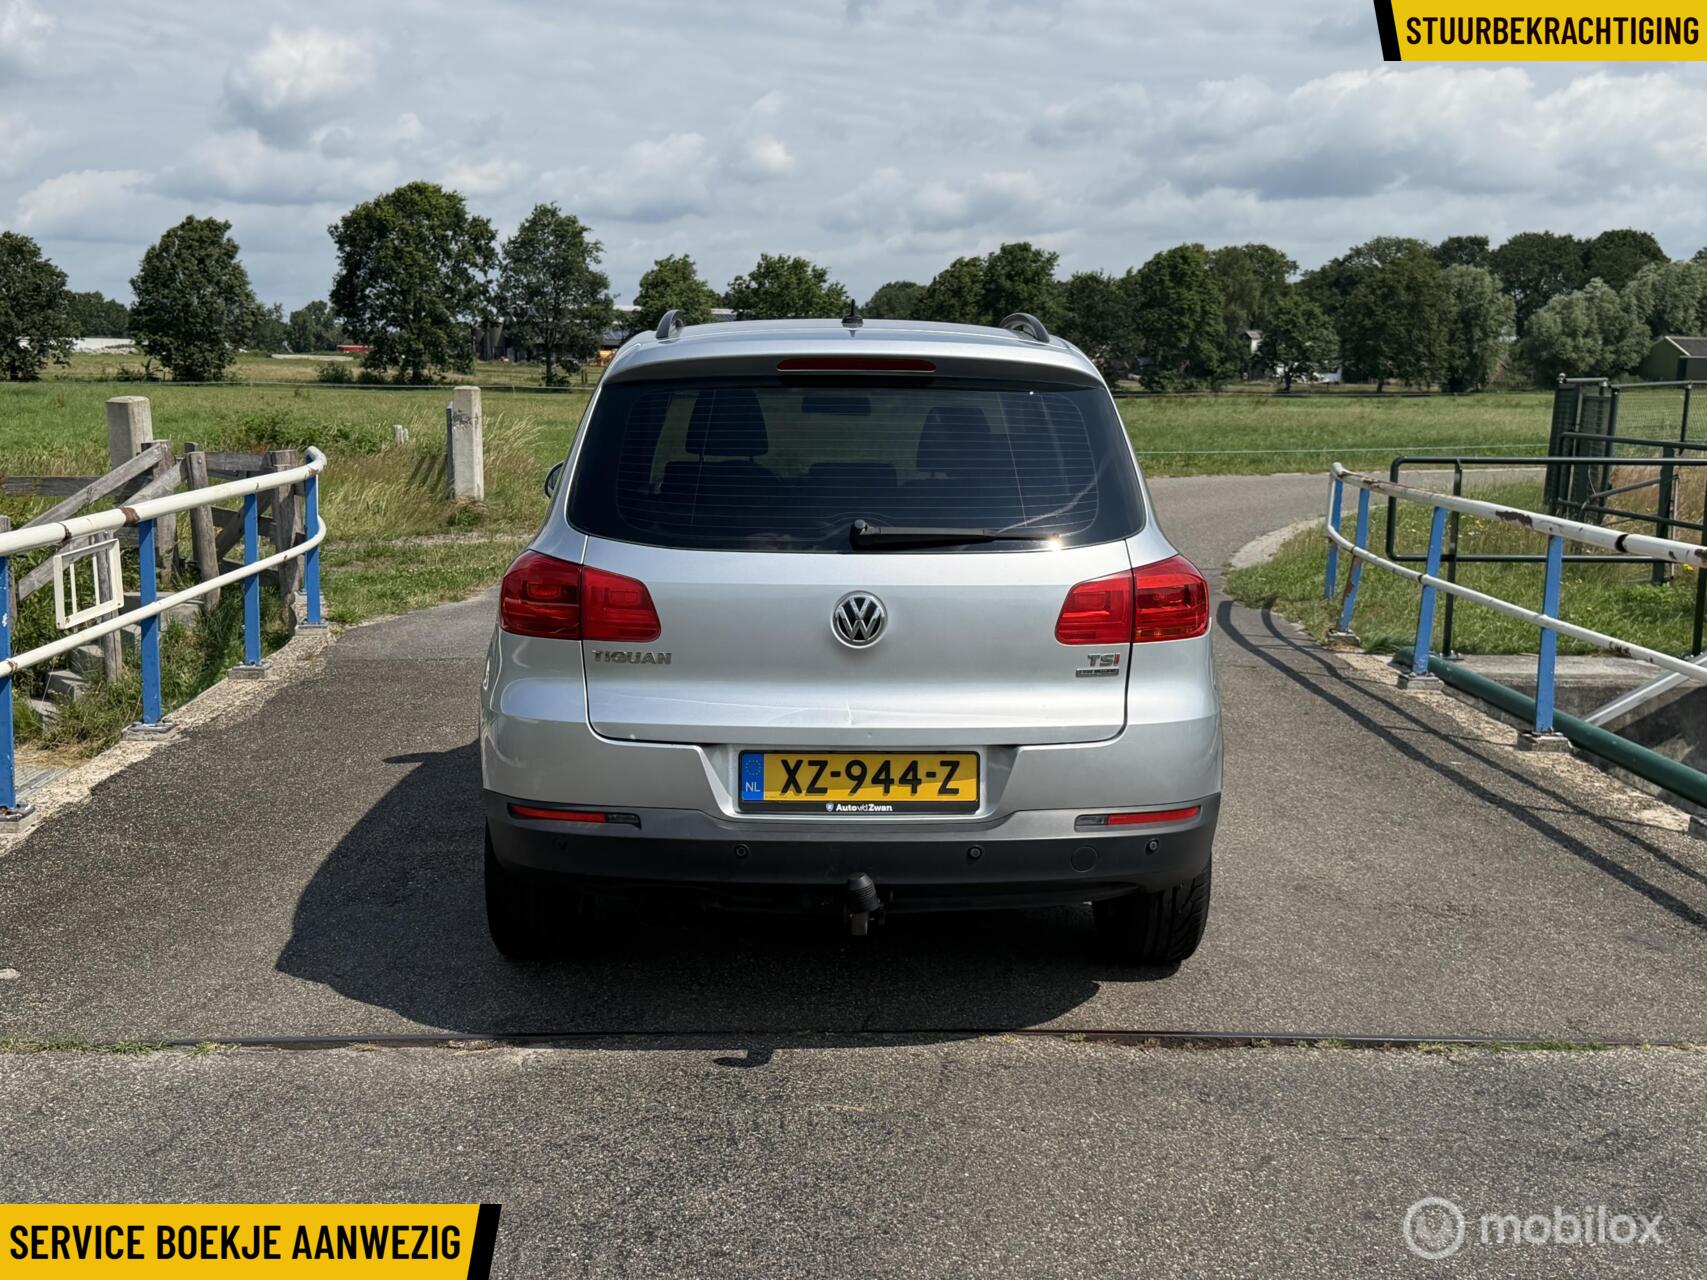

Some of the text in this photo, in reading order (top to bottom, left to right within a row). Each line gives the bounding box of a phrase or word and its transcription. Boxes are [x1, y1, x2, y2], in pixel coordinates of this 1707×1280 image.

[592, 650, 672, 665] TIGUAN
[1087, 653, 1120, 667] TSI
[780, 759, 961, 796] XZ-944-Z
[746, 782, 760, 792] NL
